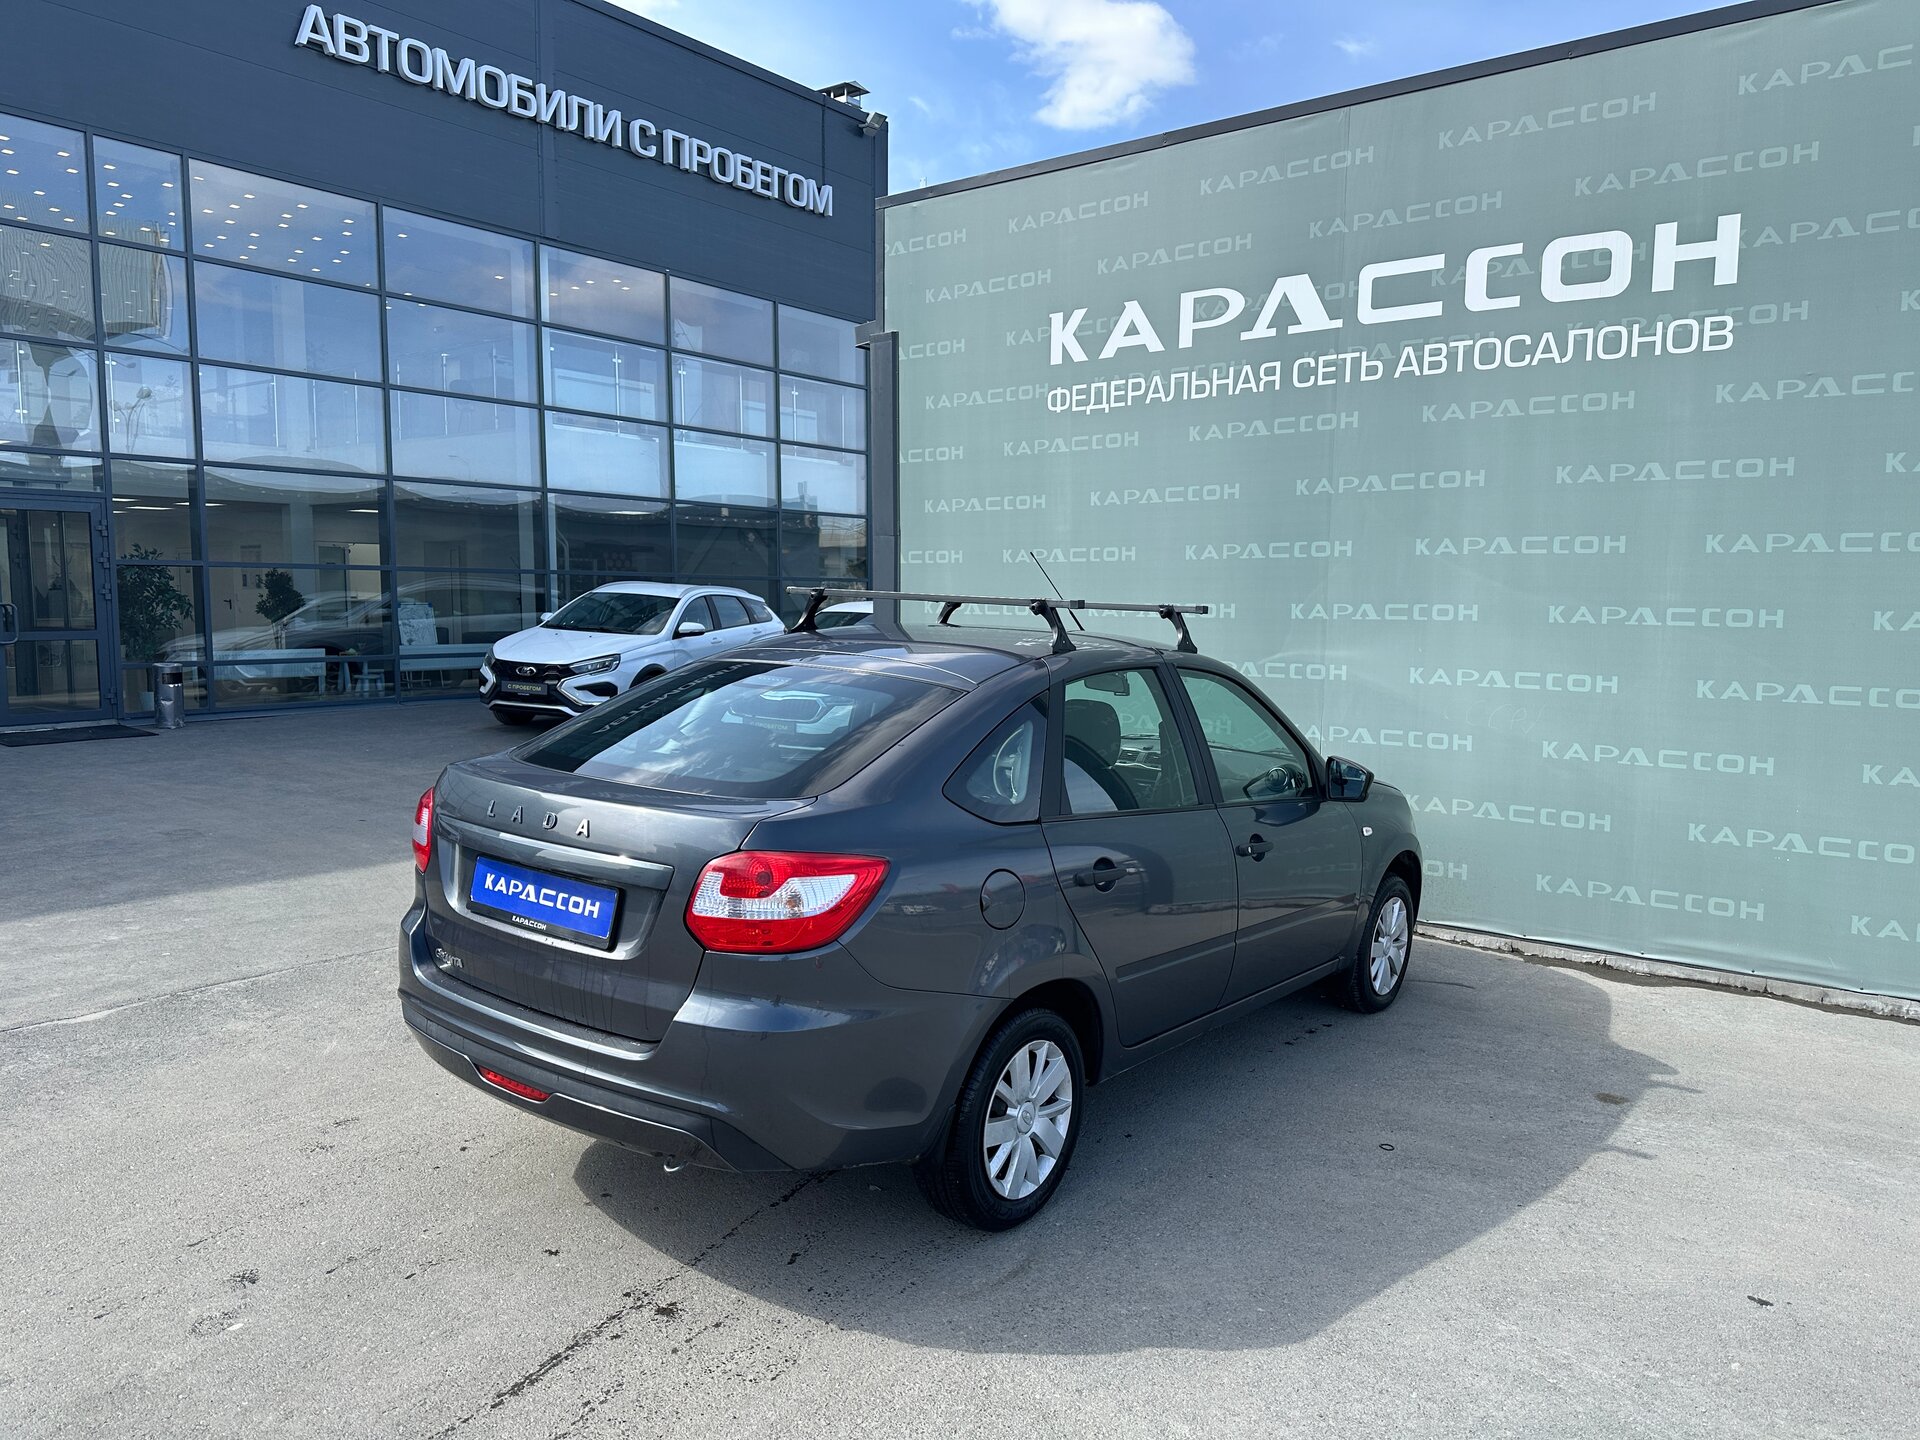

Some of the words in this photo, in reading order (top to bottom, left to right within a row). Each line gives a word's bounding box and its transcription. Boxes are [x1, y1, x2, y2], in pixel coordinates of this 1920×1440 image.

[294, 3, 622, 149] АВТОМОБИЛИ
[628, 118, 657, 159] С
[661, 127, 834, 218] ПРОБЕГОМ
[1046, 360, 1282, 416] ФЕДЕРАЛЬНАЯ
[1292, 350, 1385, 389] СЕТЬ
[1393, 315, 1735, 379] АВТОСАЛОНОВ
[512, 684, 542, 692] ПРОБЕГОМ
[486, 800, 590, 838] LADA
